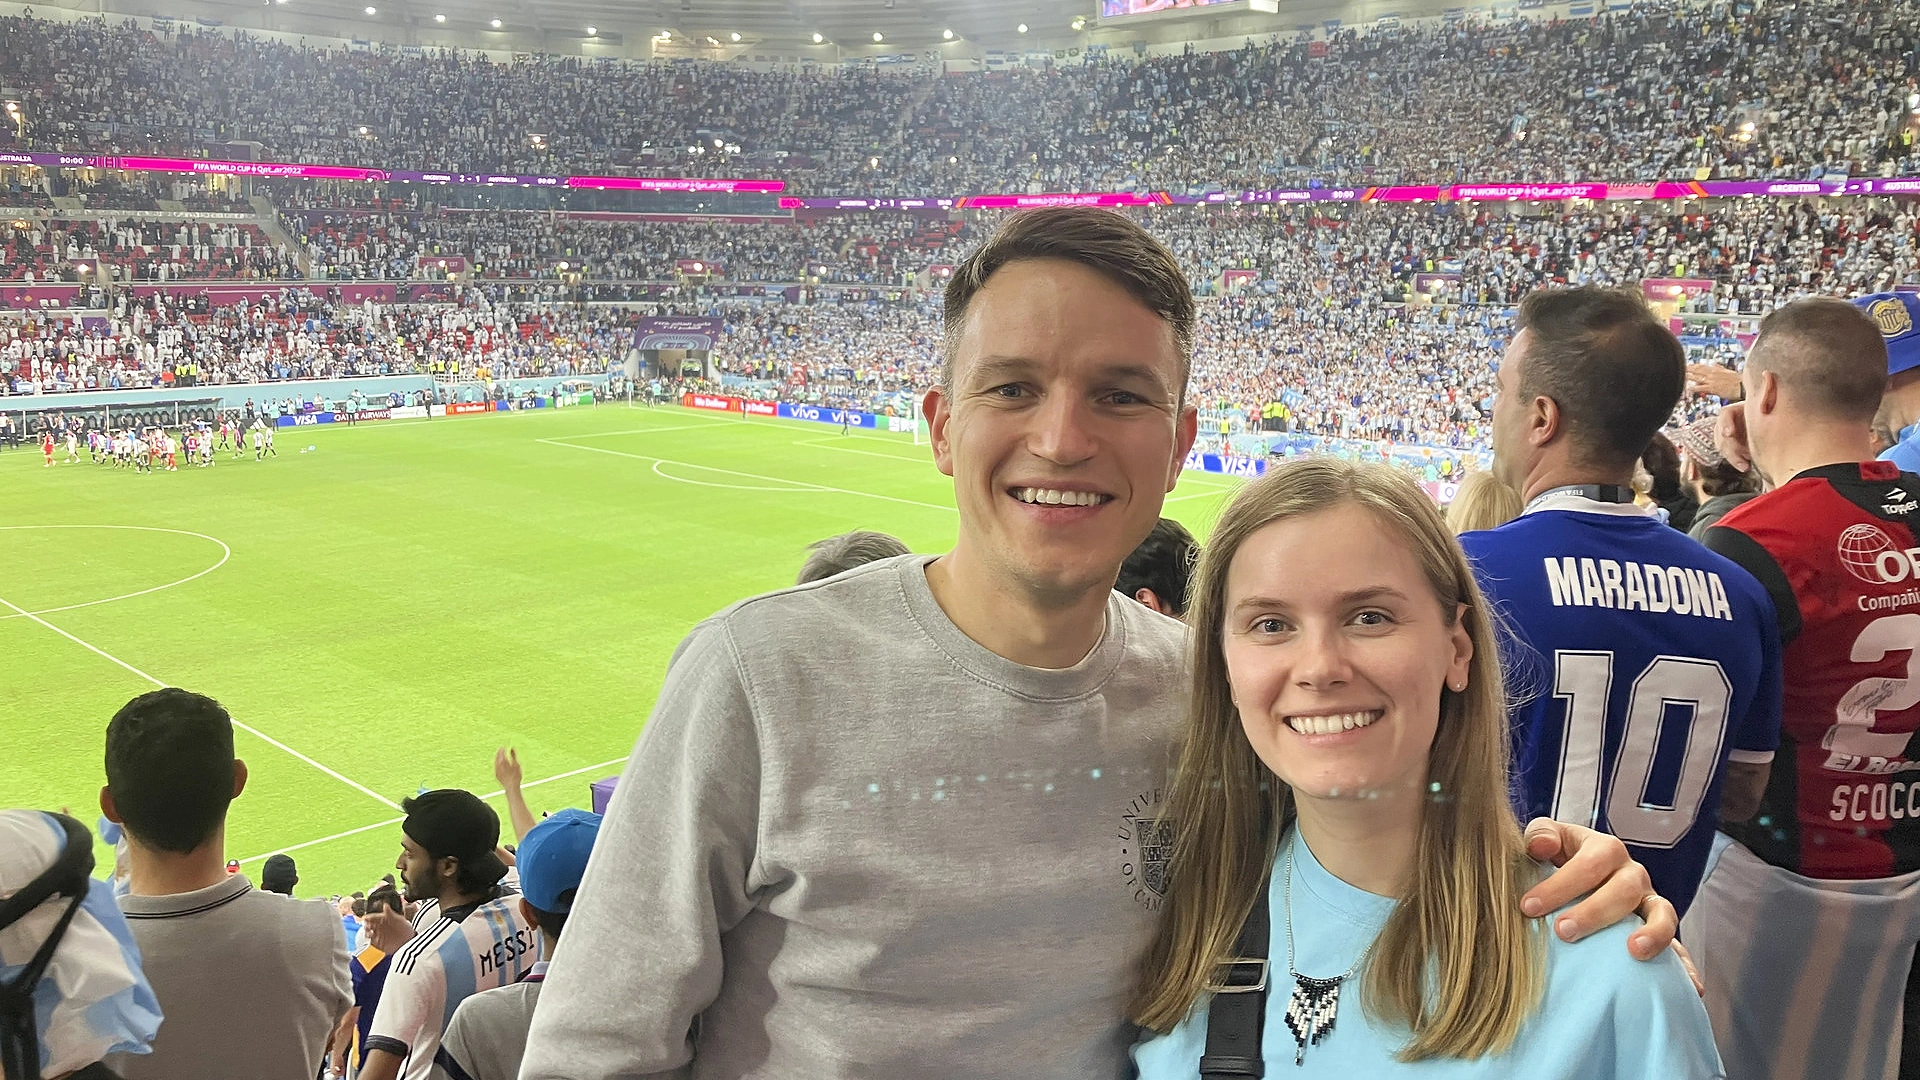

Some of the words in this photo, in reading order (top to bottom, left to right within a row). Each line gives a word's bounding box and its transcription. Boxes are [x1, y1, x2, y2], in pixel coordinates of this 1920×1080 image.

[209, 164, 236, 172] WORLD
[1459, 188, 1477, 196] FIFA
[1477, 187, 1507, 196] WORLD
[1507, 187, 1524, 195] CUP
[1769, 183, 1820, 192] ARGENTINA
[1863, 180, 1873, 192] 1
[293, 414, 318, 426] VISA
[360, 408, 391, 420] AIRWAYS
[1218, 456, 1257, 476] VISA
[1543, 556, 1733, 621] MARADONA
[1552, 649, 1734, 849] 10
